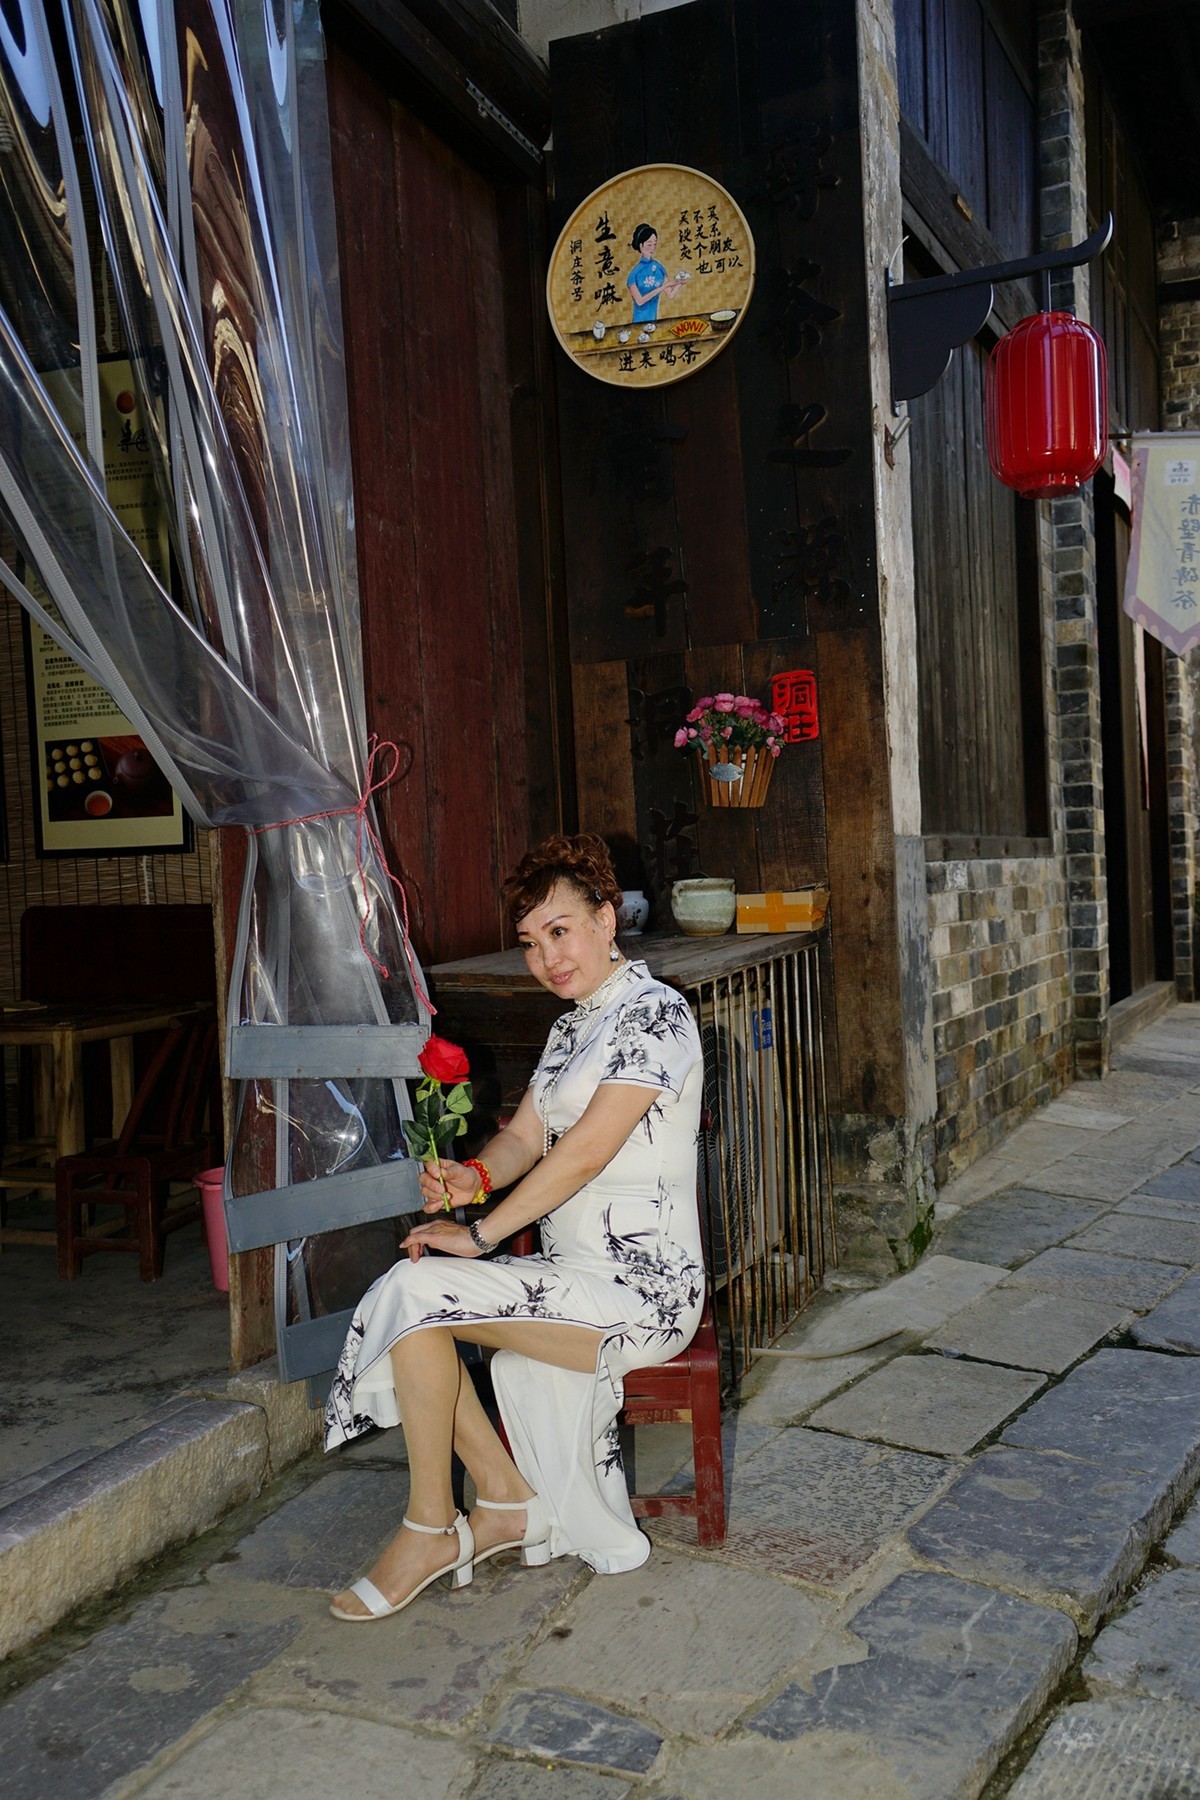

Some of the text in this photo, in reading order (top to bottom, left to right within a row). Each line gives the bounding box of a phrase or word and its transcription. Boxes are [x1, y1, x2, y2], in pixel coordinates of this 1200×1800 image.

[679, 204, 720, 225] 买不买
[680, 237, 737, 260] 交个朋友
[570, 239, 585, 302] 洞庄茶号
[594, 211, 622, 312] 生意嘛
[696, 255, 743, 274] 也可以
[672, 320, 704, 336] WOW!
[618, 341, 701, 372] 进来喝茶
